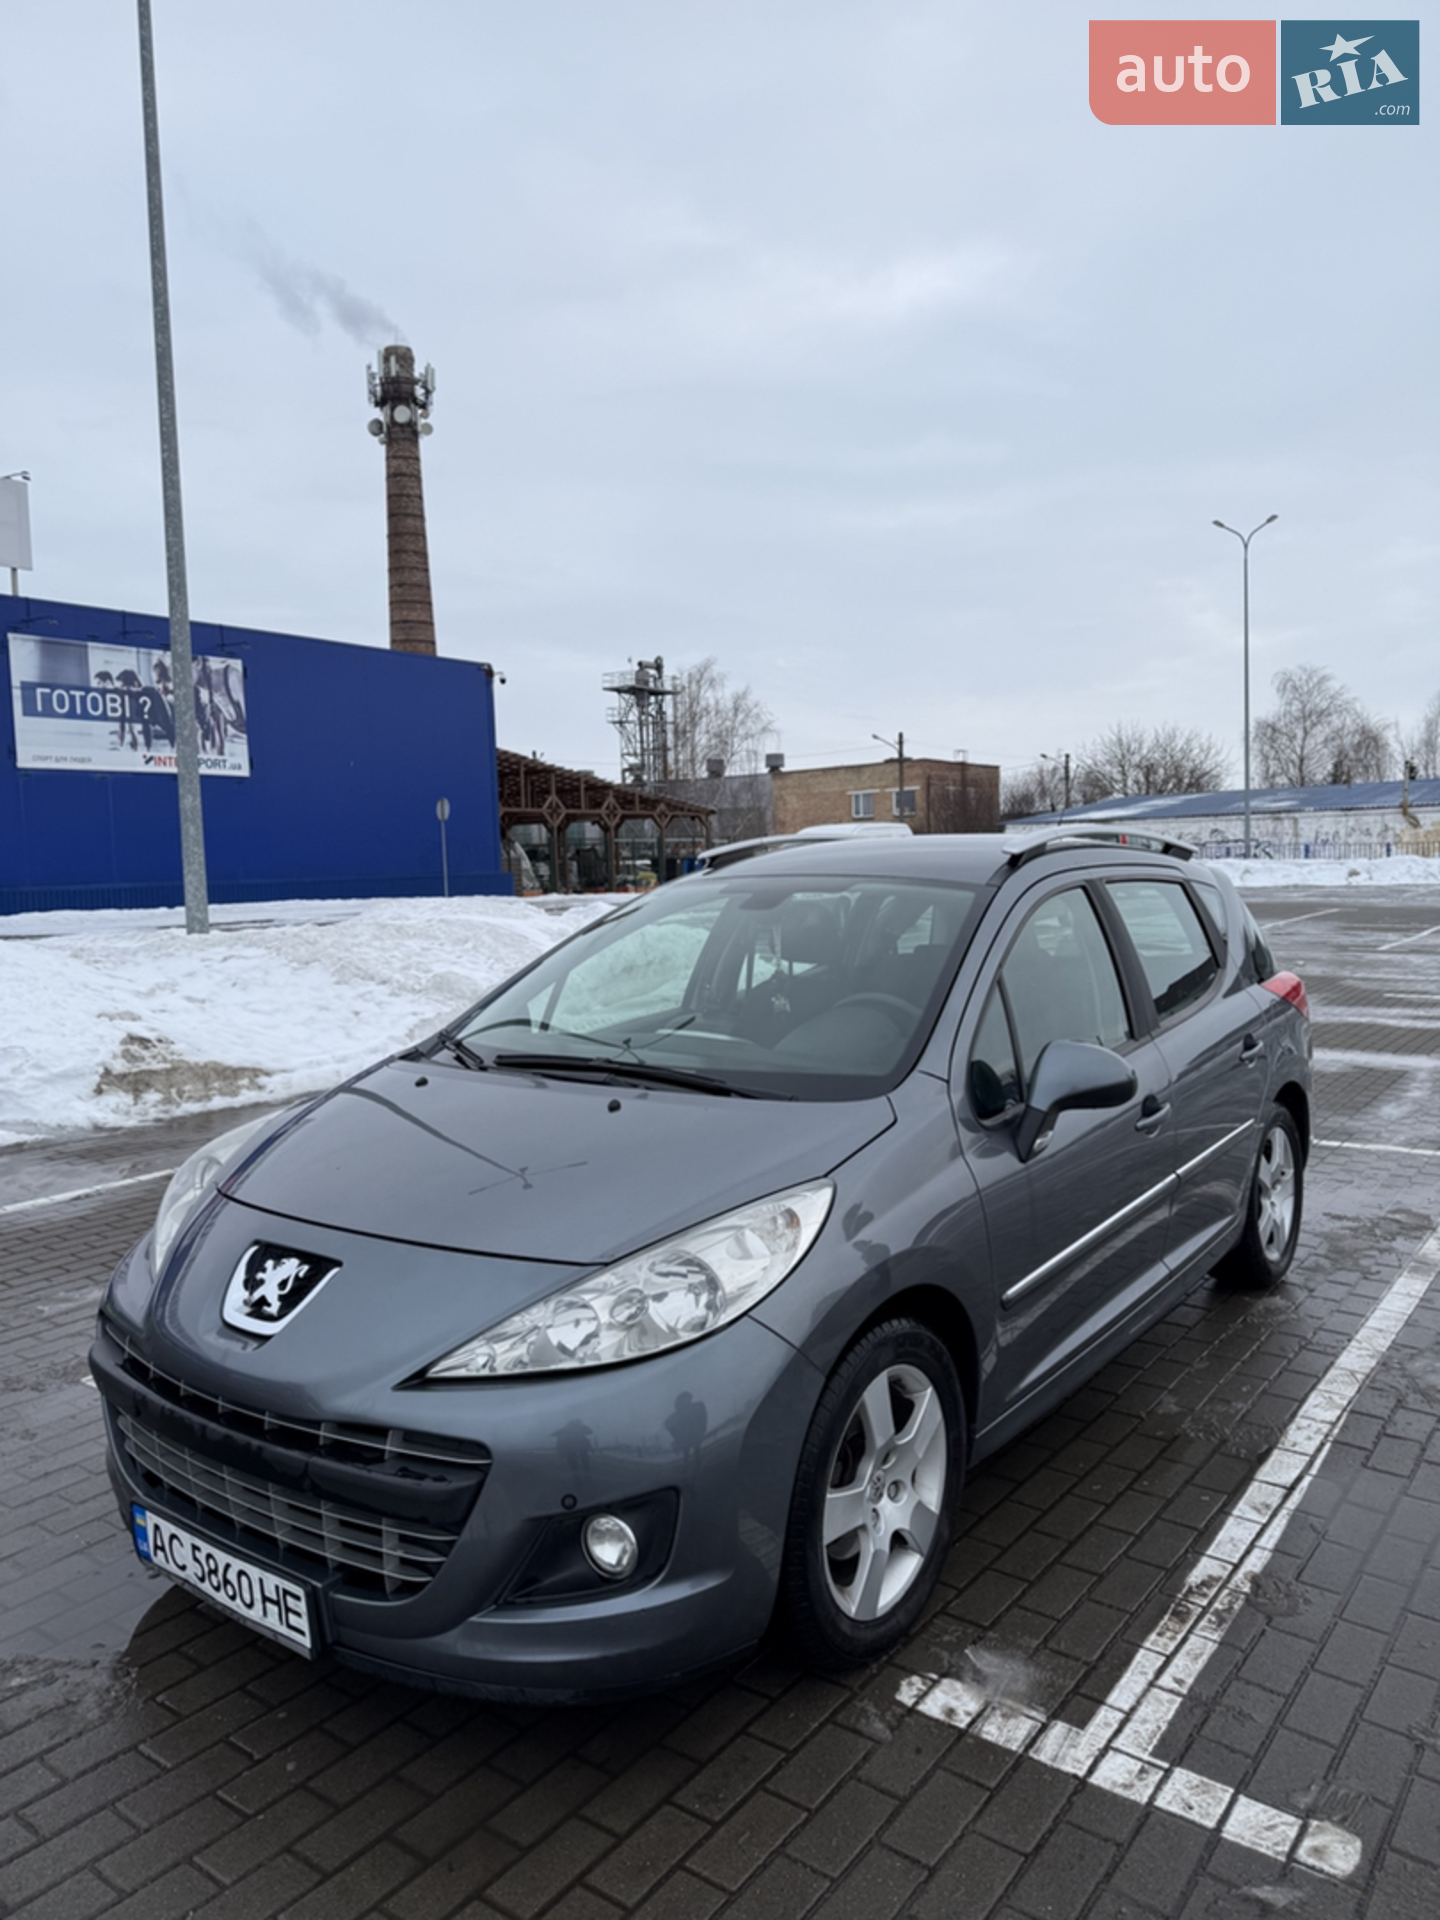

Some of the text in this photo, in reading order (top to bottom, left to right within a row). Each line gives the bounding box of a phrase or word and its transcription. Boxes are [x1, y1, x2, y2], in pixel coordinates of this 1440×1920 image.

[36, 688, 151, 719] ГОТОВІ ?
[153, 1522, 306, 1637] AC 5860 HE
